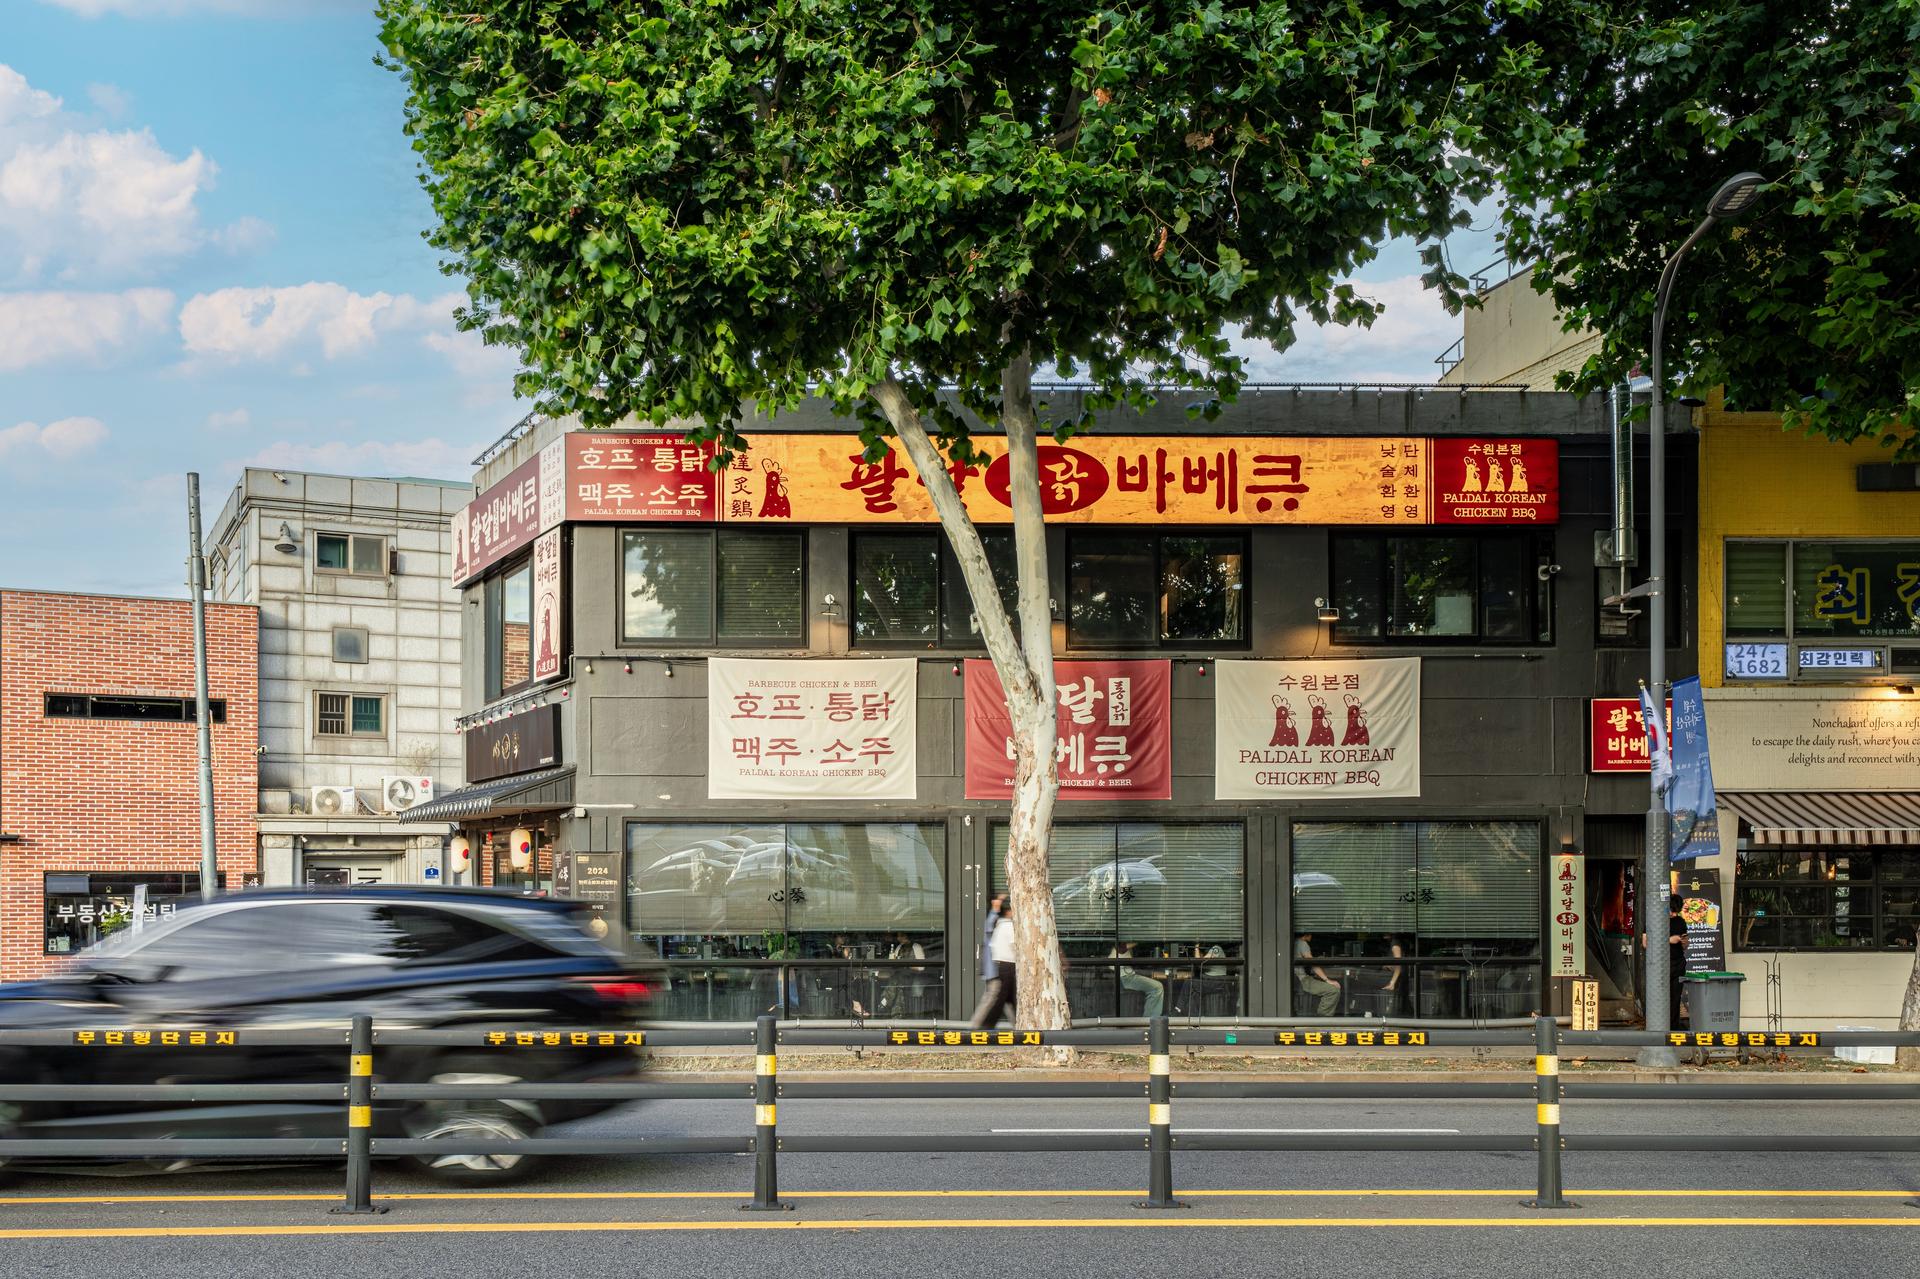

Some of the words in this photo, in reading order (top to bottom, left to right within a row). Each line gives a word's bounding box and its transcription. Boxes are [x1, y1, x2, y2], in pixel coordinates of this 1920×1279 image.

[1468, 443, 1522, 455] 수원본점
[731, 444, 753, 518] 達炙鷄
[1380, 443, 1397, 519] 낮술환영
[1403, 443, 1420, 519] 단체환영
[1443, 493, 1491, 503] PALDAL
[1494, 493, 1547, 503] KOREAN
[584, 508, 614, 516] PALDAL
[616, 508, 648, 516] KOREAN
[650, 508, 683, 516] CHICKEN
[686, 509, 702, 517] BBQ
[1453, 507, 1508, 518] CHICKEN
[1512, 507, 1537, 520] BBQ
[1735, 644, 1777, 659] 247-
[1736, 659, 1781, 674] 1682
[748, 680, 797, 688] BARBECUE
[799, 680, 840, 688] CHICKEN
[854, 680, 878, 688] BEER
[1278, 674, 1360, 691] 수원본점
[1812, 717, 1866, 728] Nonchalant
[1869, 716, 1895, 731] offers
[1897, 720, 1903, 728] a
[1752, 736, 1761, 746] to
[1763, 738, 1793, 749] escape
[1795, 735, 1810, 746] the
[1812, 735, 1834, 749] daily
[1837, 735, 1861, 746] rush,
[1863, 734, 1891, 746] where
[1892, 736, 1910, 749] you
[1239, 749, 1312, 764] PALDAL
[1320, 747, 1396, 764] KOREAN
[1788, 752, 1825, 767] delights
[1827, 753, 1846, 764] and
[1848, 754, 1893, 764] reconnect
[1895, 752, 1915, 764] with
[739, 769, 776, 778] PALDAL
[779, 769, 818, 778] KOREAN
[822, 769, 864, 778] CHICKEN
[868, 769, 887, 779] BBQ
[1255, 771, 1337, 786] CHICKEN
[1344, 769, 1380, 787] BBQ
[1109, 778, 1133, 787] BEER
[587, 867, 608, 875] 2024
